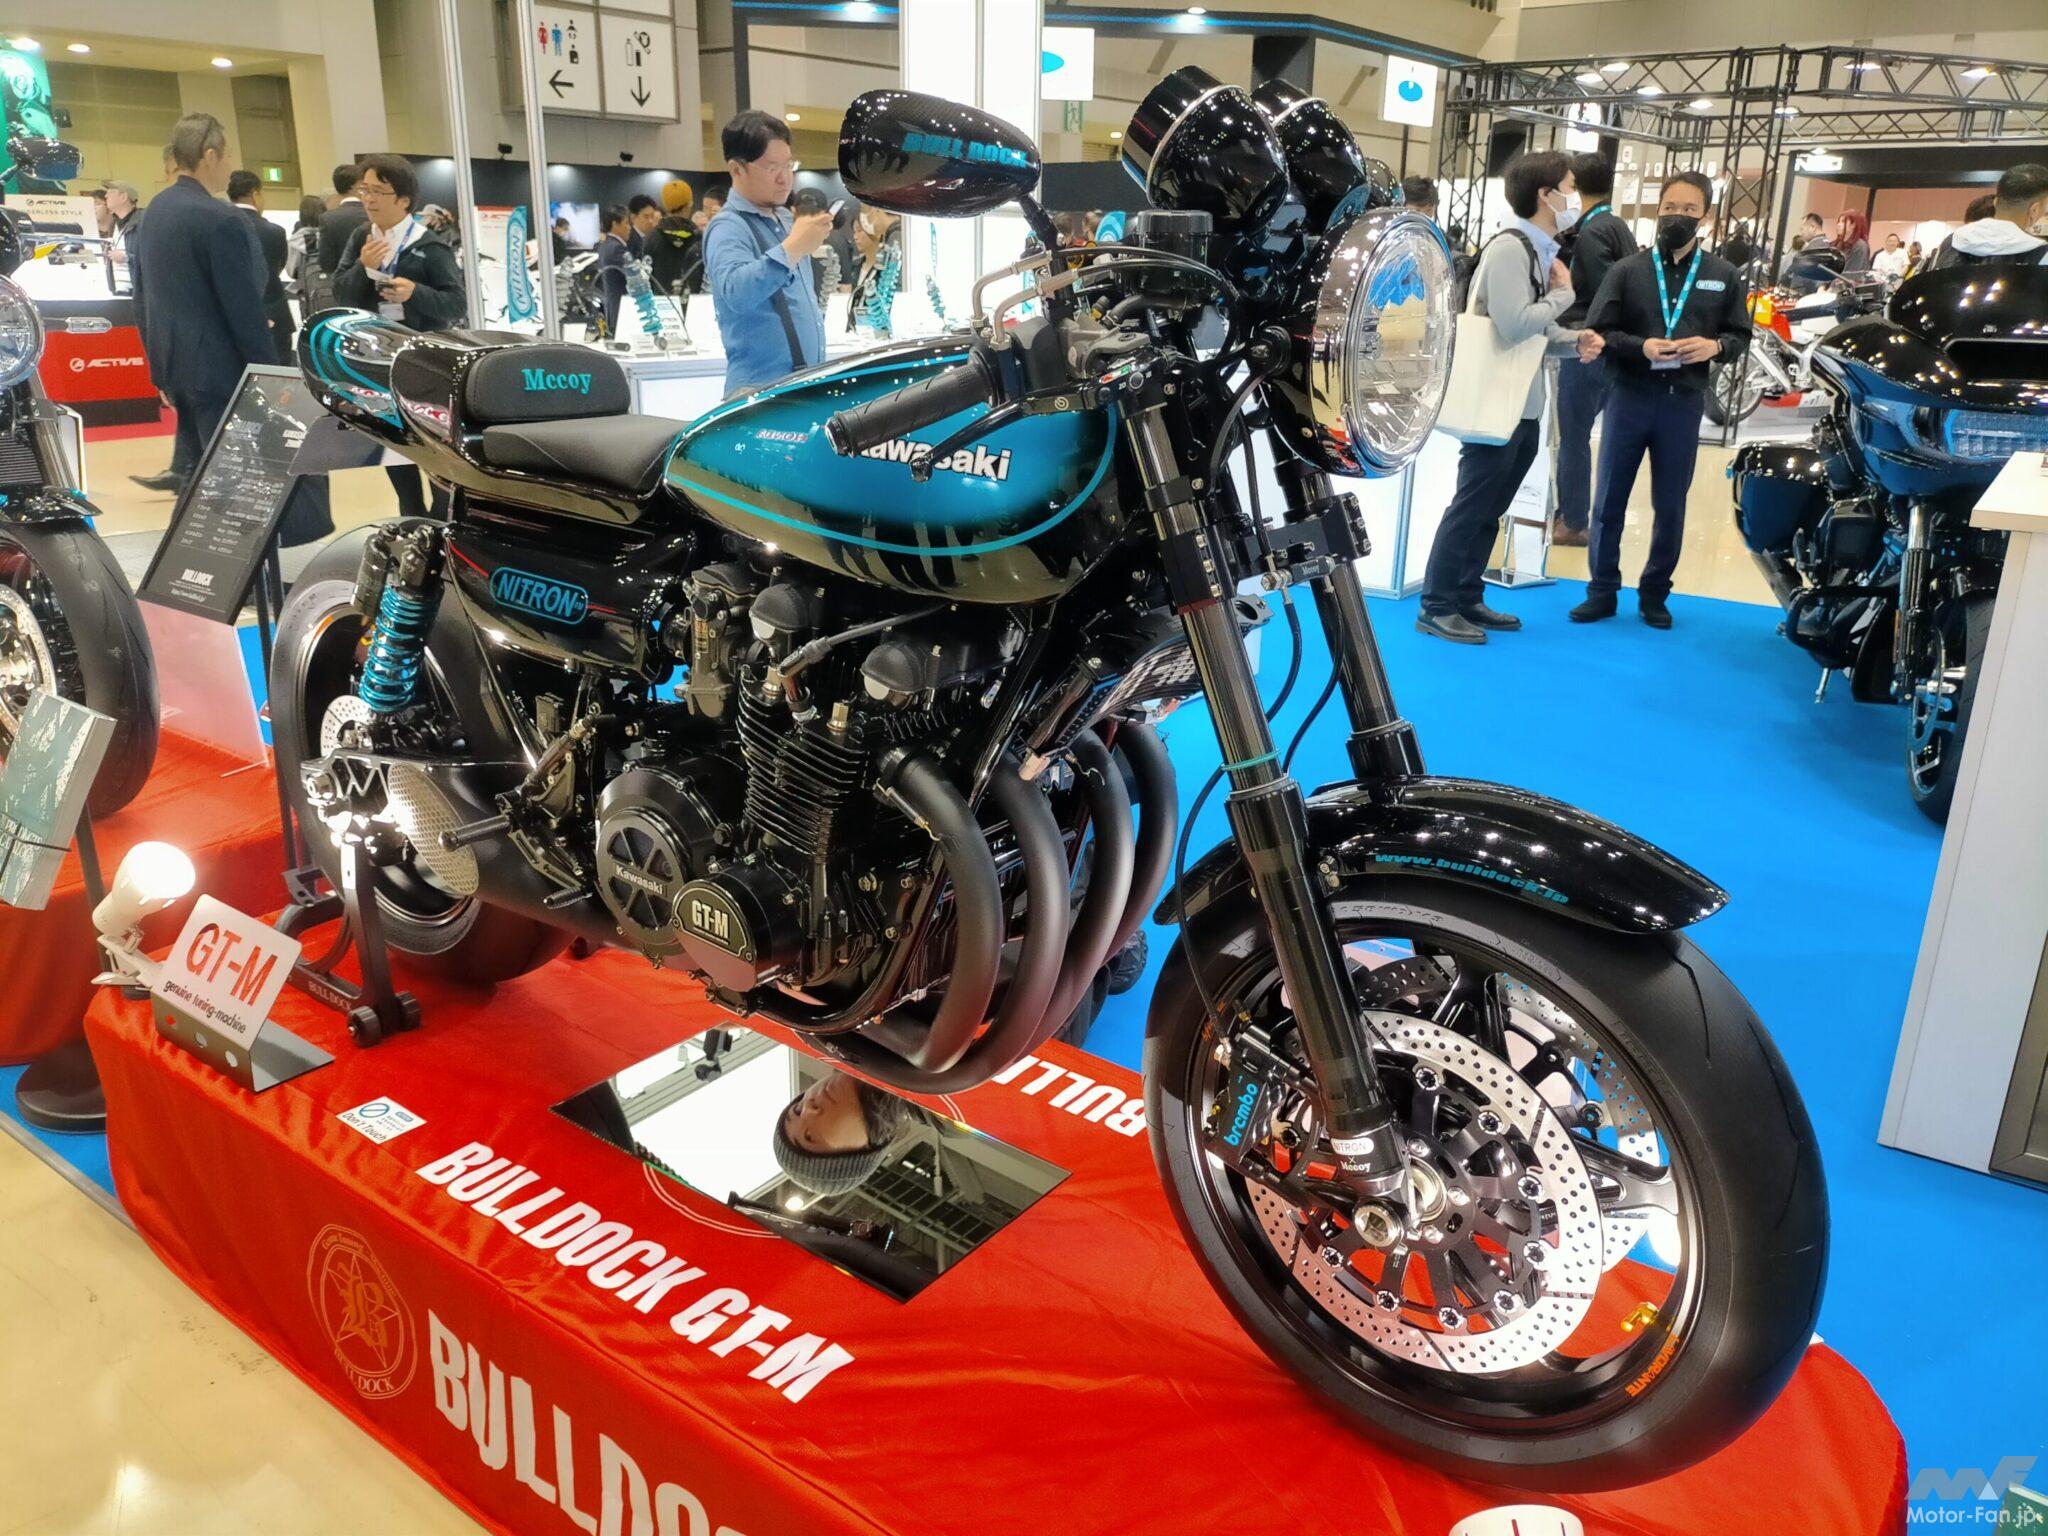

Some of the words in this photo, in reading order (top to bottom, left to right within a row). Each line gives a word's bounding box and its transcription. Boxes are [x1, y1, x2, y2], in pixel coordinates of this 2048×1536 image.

[87, 357, 144, 366] ACTIVE
[521, 368, 592, 395] Mccoy
[497, 573, 579, 617] NITRON
[615, 864, 663, 895] Kawasaki
[1375, 854, 1569, 903] www.bulldock.jp
[691, 899, 729, 939] GT-M
[186, 922, 278, 1007] GT-M
[163, 980, 193, 1001] genuine
[1223, 1083, 1259, 1146] brembo
[415, 1141, 707, 1314] BULLDOCK
[669, 1287, 855, 1404] GT-M
